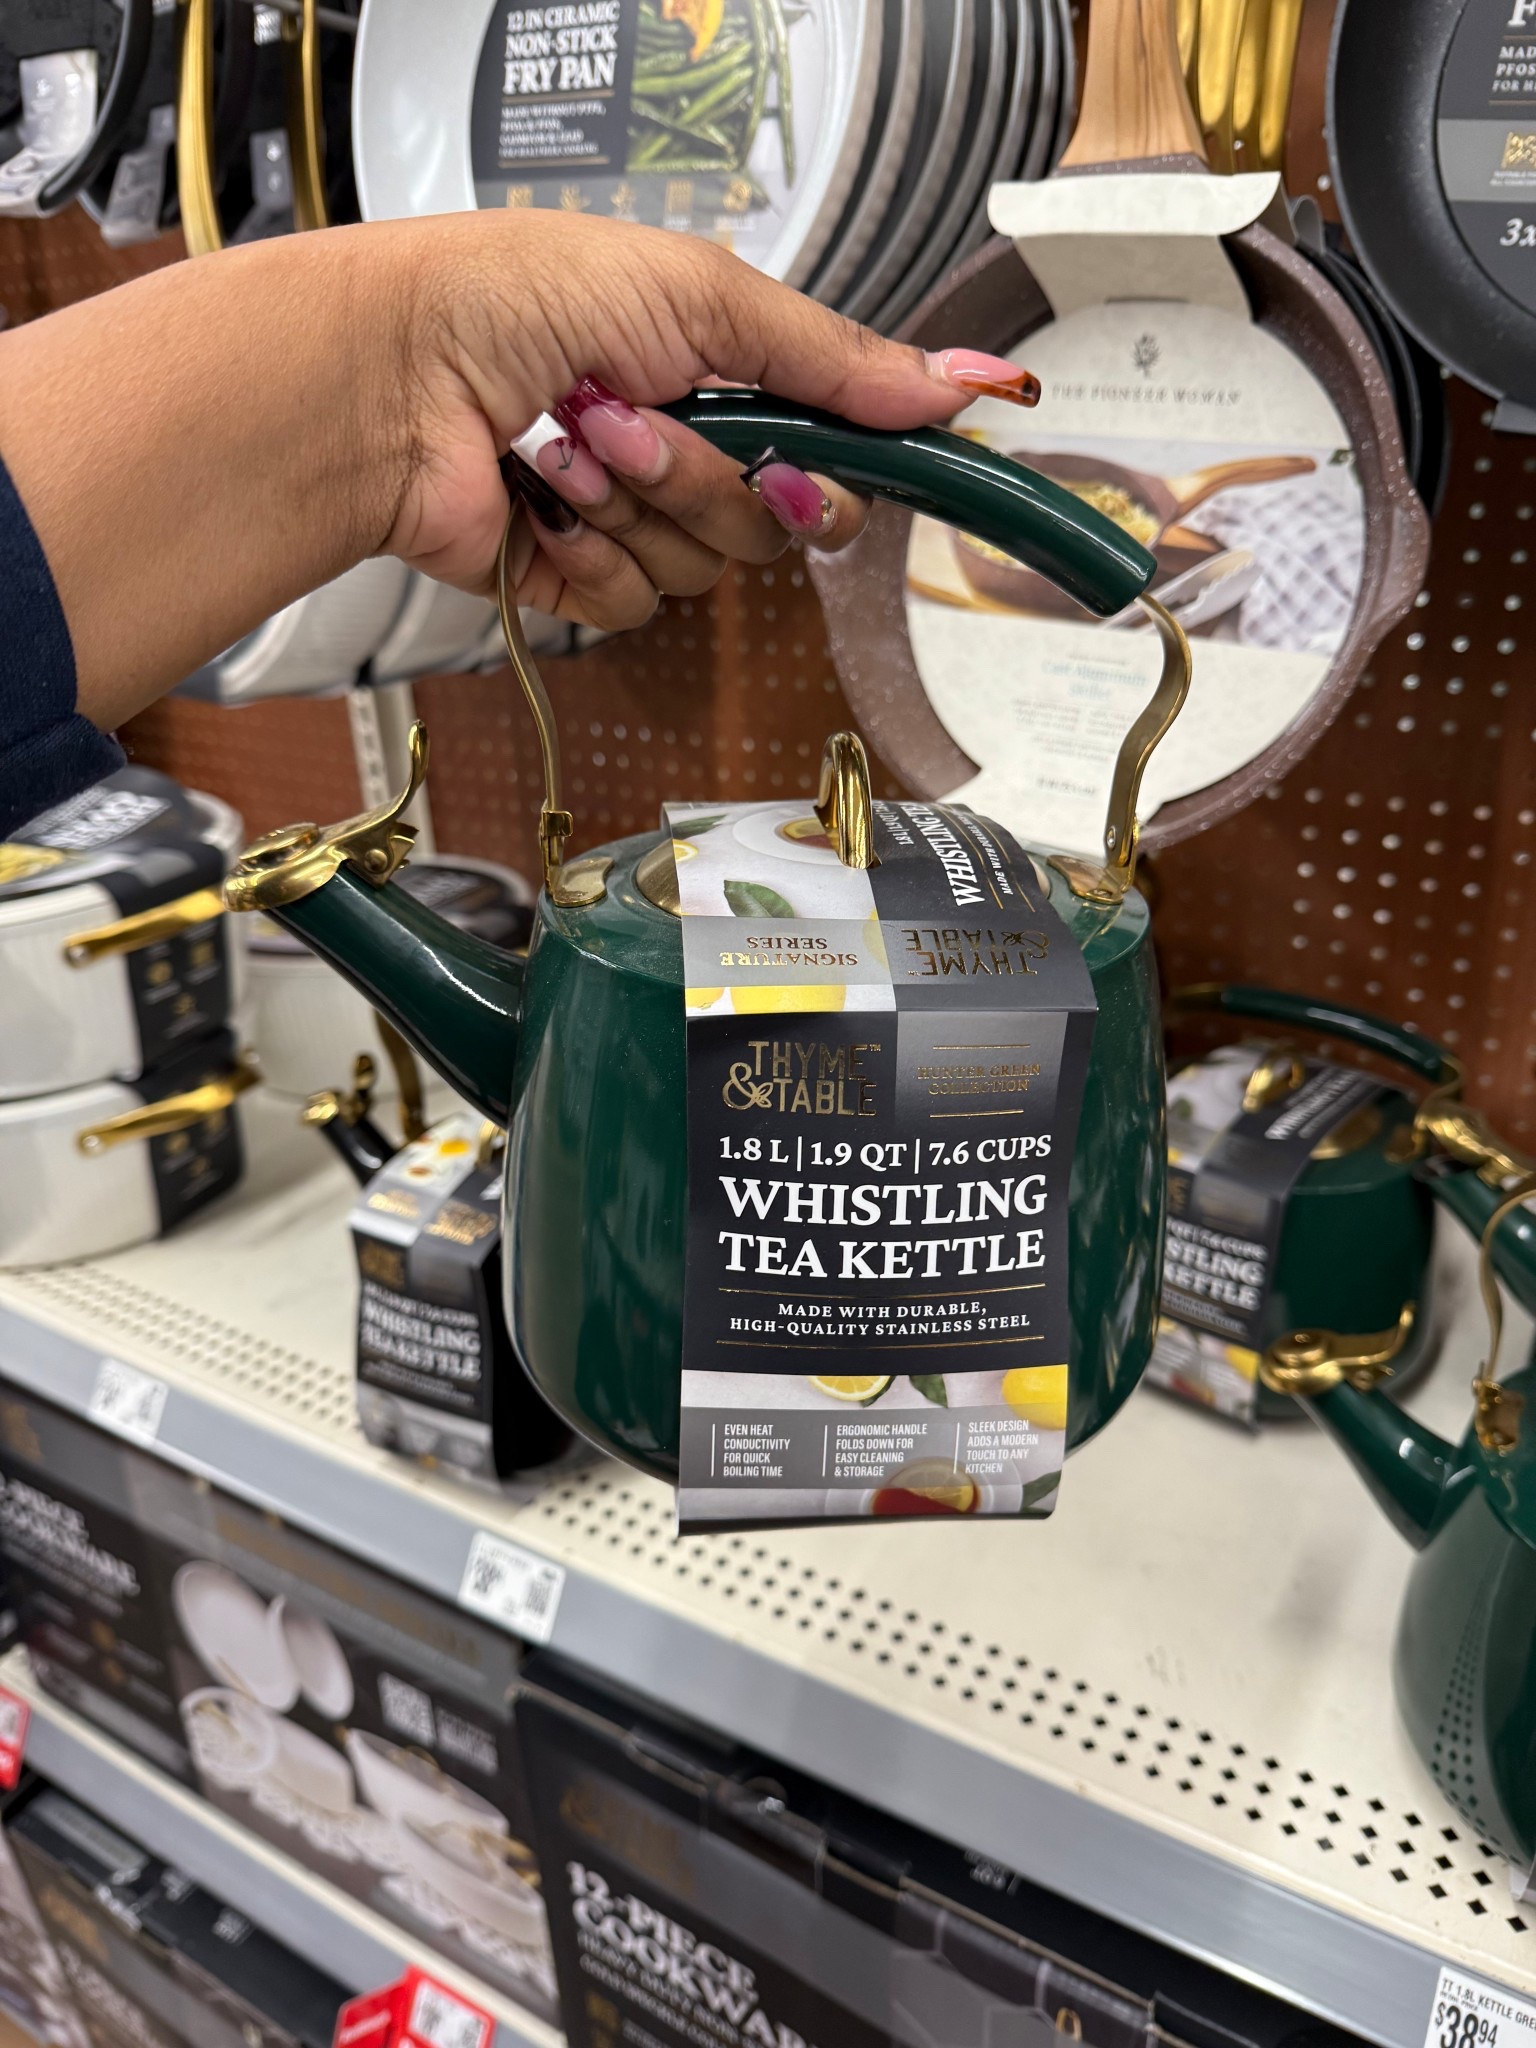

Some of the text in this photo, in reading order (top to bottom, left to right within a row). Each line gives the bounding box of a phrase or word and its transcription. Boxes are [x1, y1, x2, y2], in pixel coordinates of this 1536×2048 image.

[507, 1, 620, 32] 12 IN CERAMIC
[505, 23, 619, 59] NON-STICK
[503, 51, 618, 95] FRY PAN
[1492, 80, 1520, 92] FOR
[914, 818, 985, 907] WHISTLING
[984, 847, 1002, 869] WITH
[994, 870, 1014, 895] MADE
[747, 937, 827, 949] SERIES
[720, 952, 858, 966] SIGNATURE
[917, 1063, 1041, 1080] HUNTER GREEN
[928, 1079, 1030, 1095] COLLECTION
[719, 1134, 1052, 1170] 1.8 L 1.9 QT 7.6 CUPS
[718, 1173, 1048, 1226] WHISTLING
[718, 1228, 1046, 1279] TEA KETTLE
[778, 1302, 987, 1318] MADE WITH DURABLE,
[730, 1314, 1030, 1335] HIGH-QUALITY STAINLESS STEEL
[724, 1423, 774, 1436] EVEN HEAT
[836, 1423, 928, 1436] ERGONOMIC HANDLE
[968, 1419, 1029, 1433] SLEEK DESIGN
[724, 1438, 791, 1450] CONDUCTIVITY
[836, 1437, 914, 1450] FOLDS DOWN FOR
[967, 1433, 1039, 1447] ADDS A MODERN
[723, 1452, 771, 1464] FOR QUICK
[835, 1451, 904, 1463] EASY CLEANING
[966, 1448, 1030, 1461] TOUCH TO ANY
[723, 1465, 783, 1477] BOILING TIME
[834, 1465, 884, 1477] & STORAGE
[965, 1462, 1003, 1474] KITCHEN
[573, 1896, 820, 2048] COOKWAR
[1442, 1978, 1454, 1991] TT
[1456, 1985, 1475, 2002] 1.8L
[1478, 1994, 1514, 2020] KETTLE
